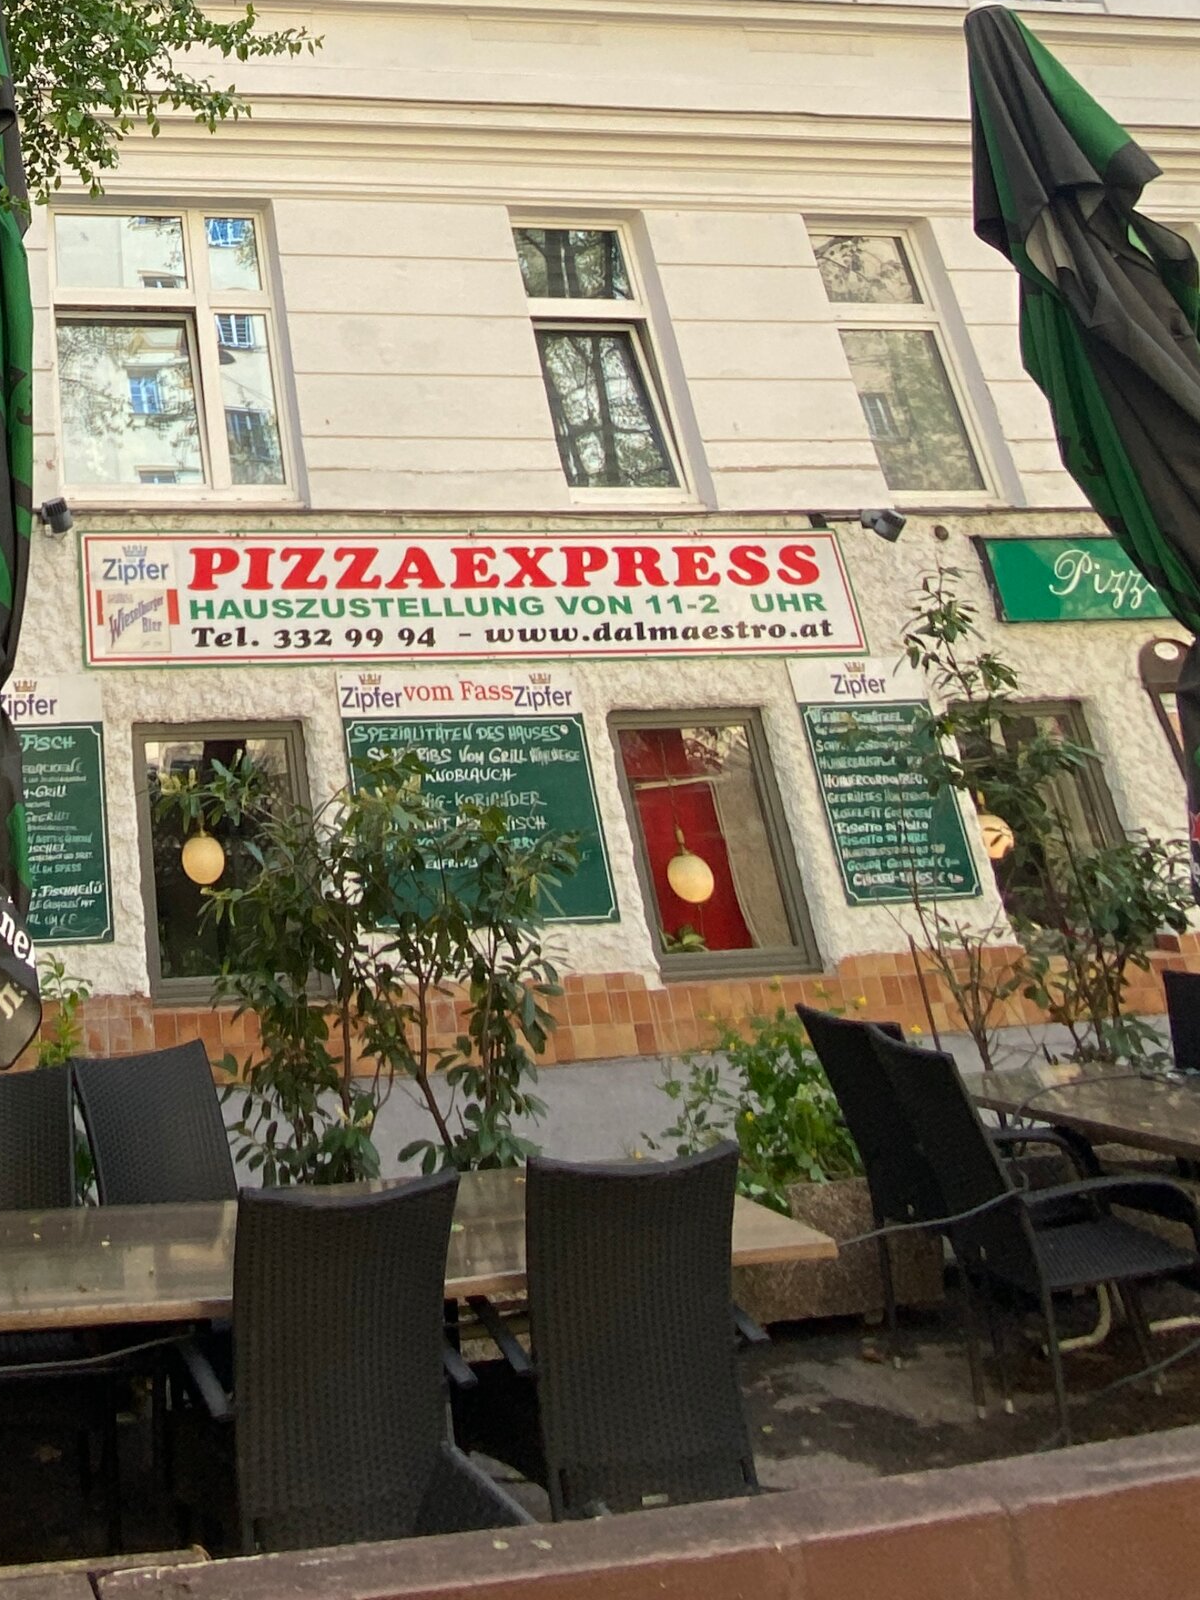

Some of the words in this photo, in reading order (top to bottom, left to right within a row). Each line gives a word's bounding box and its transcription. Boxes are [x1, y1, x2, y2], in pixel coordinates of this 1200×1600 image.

[102, 558, 169, 585] Zipfer
[187, 544, 820, 591] PIZZAEXPRESS
[1049, 549, 1157, 609] Pizz
[189, 595, 545, 620] HAUSZUSTELLUNG
[556, 595, 633, 616] VON
[645, 594, 720, 614] 11-2
[751, 593, 828, 613] UHR
[192, 626, 260, 648] Tel.
[273, 629, 332, 649] 332
[345, 628, 383, 648] 99
[397, 627, 436, 648] 94
[485, 619, 834, 644] www.dalmaestro.at
[340, 686, 402, 712] Zipfer
[403, 684, 454, 701] vom
[459, 681, 514, 701] Fass
[513, 685, 573, 711] Zipfer
[830, 673, 886, 698] Zipfer
[0, 693, 58, 720] ipfer
[476, 725, 504, 741] DES
